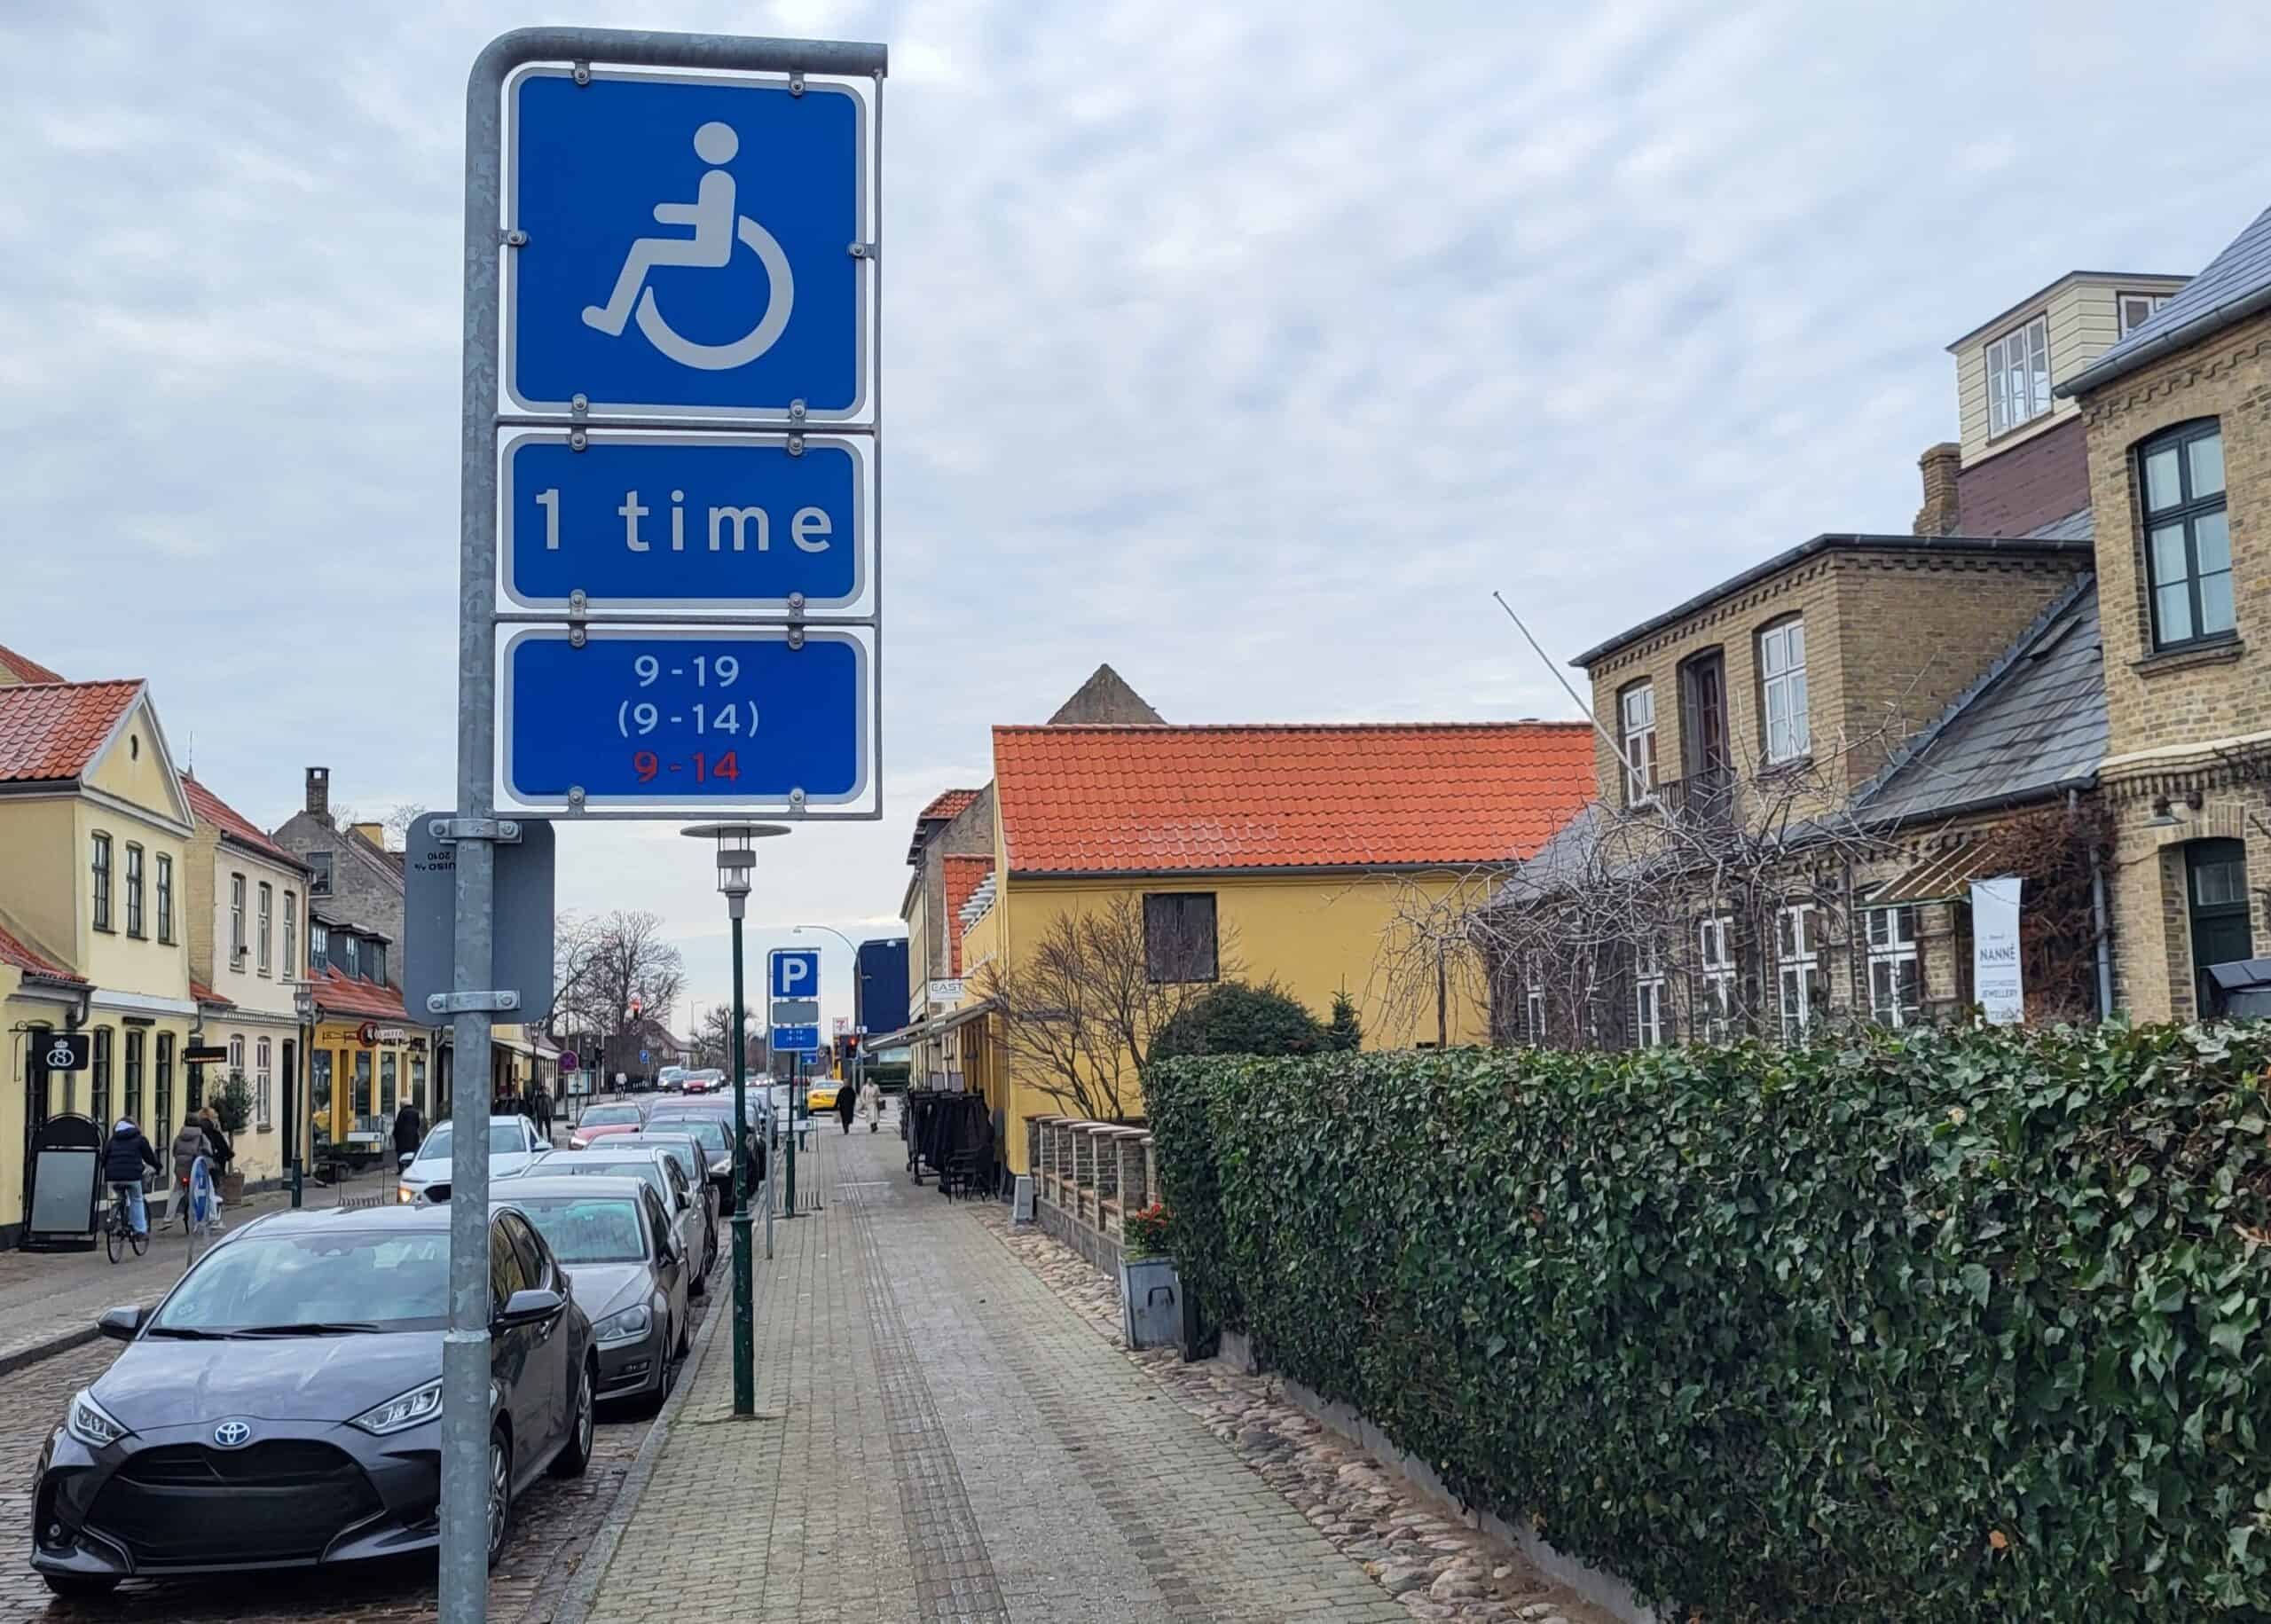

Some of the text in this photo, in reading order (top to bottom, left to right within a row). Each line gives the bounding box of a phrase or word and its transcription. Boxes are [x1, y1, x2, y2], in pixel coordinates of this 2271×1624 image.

[536, 489, 832, 553] 1 time
[633, 655, 740, 687] 9-19
[618, 701, 759, 738] (9-14)
[633, 751, 740, 782] 9-14
[428, 851, 450, 860] 2010
[782, 958, 808, 993] P
